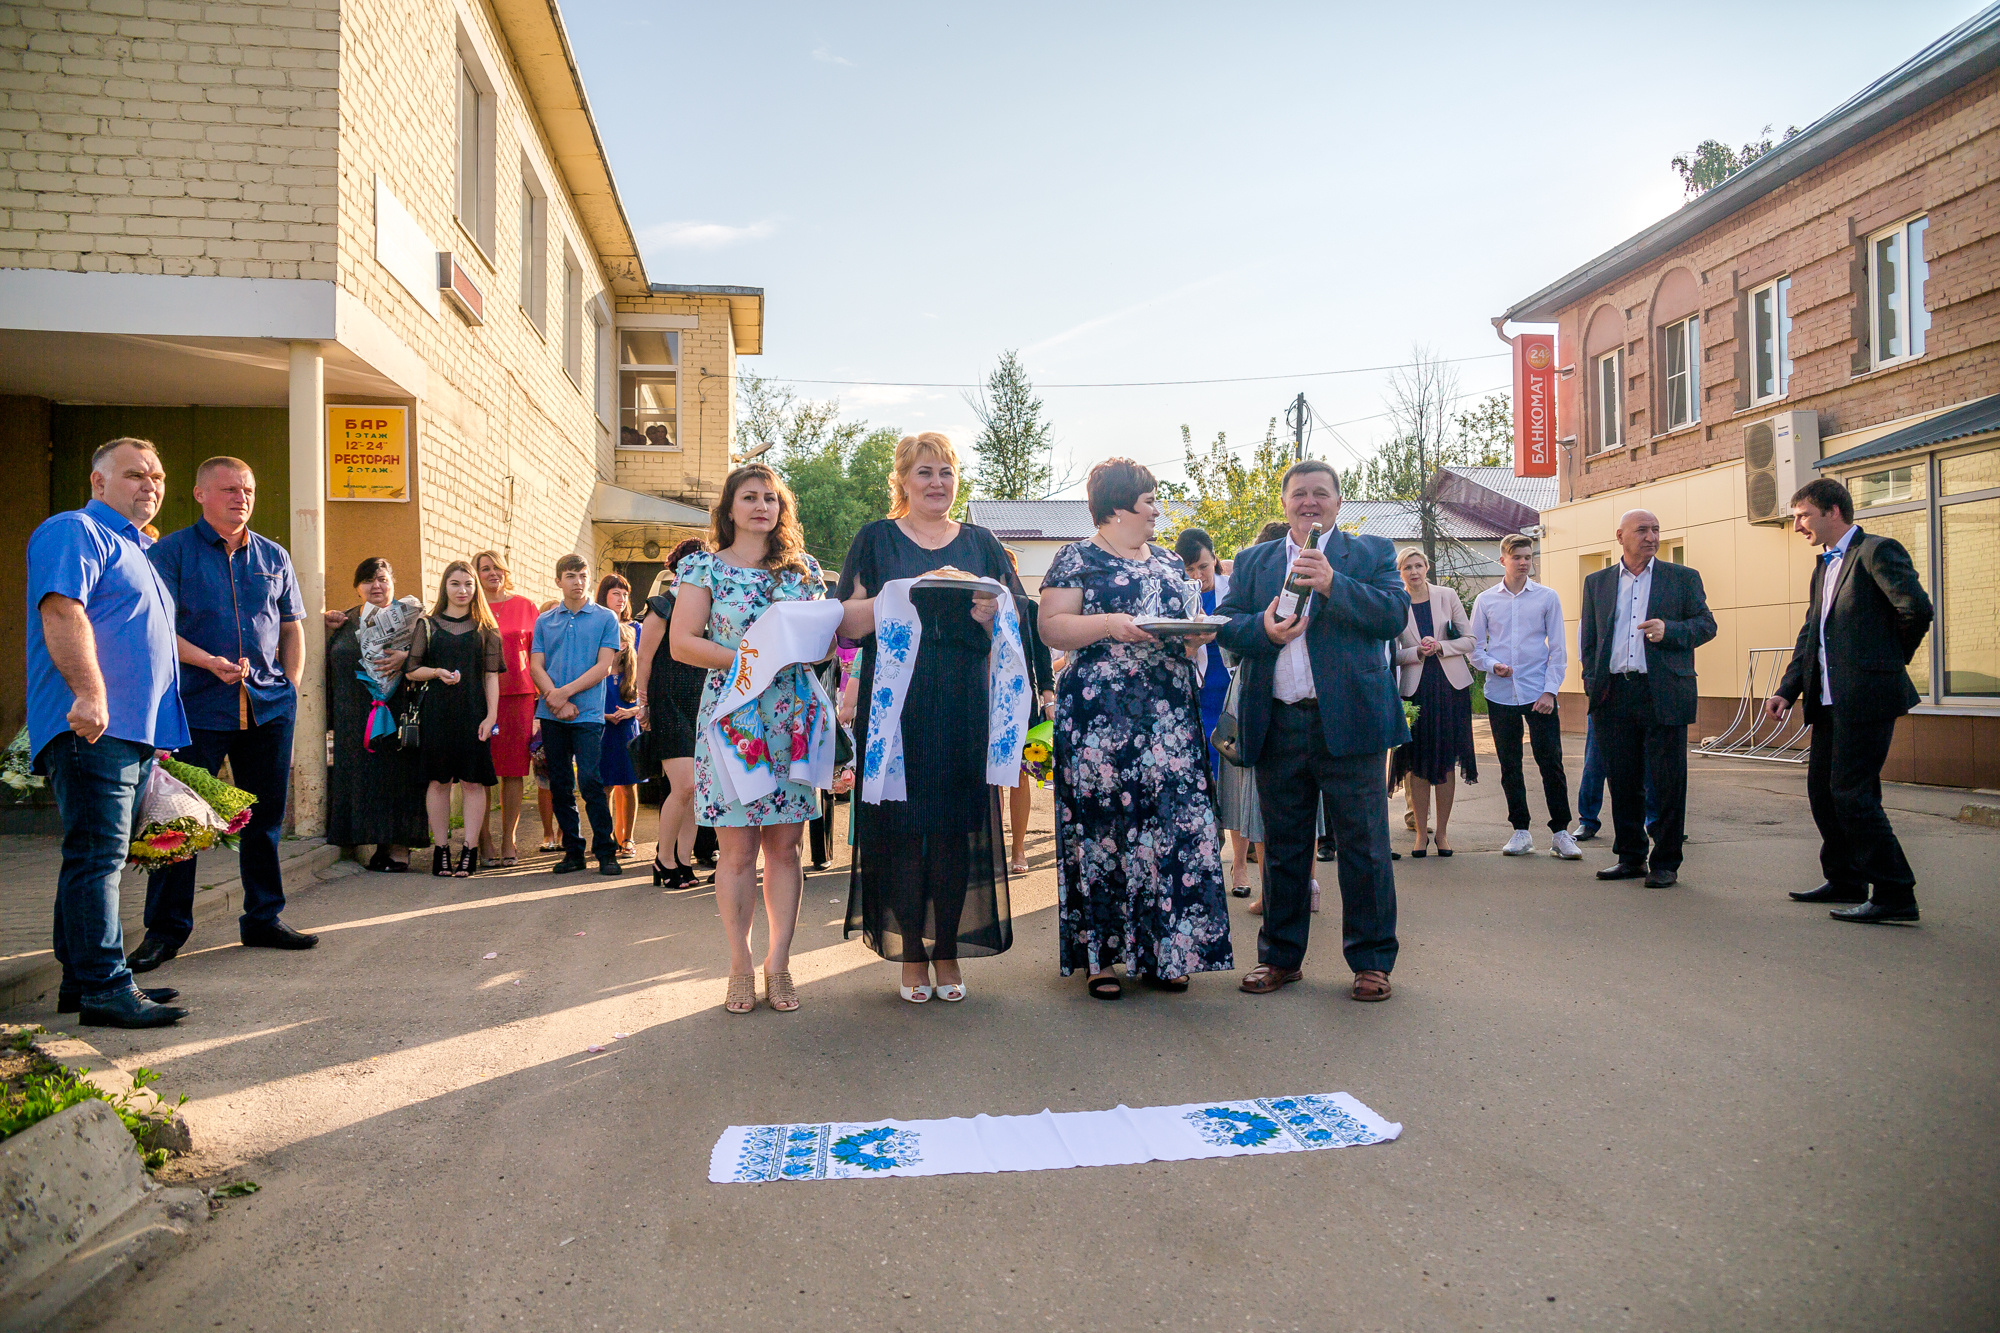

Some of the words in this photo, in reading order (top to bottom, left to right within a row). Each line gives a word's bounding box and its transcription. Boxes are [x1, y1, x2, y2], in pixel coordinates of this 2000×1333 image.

[1530, 349, 1545, 359] 24
[345, 419, 388, 430] БАР
[1530, 374, 1544, 464] БАНКОМАТ
[334, 454, 400, 465] РЕСТОРАН
[390, 608, 401, 625] POST
